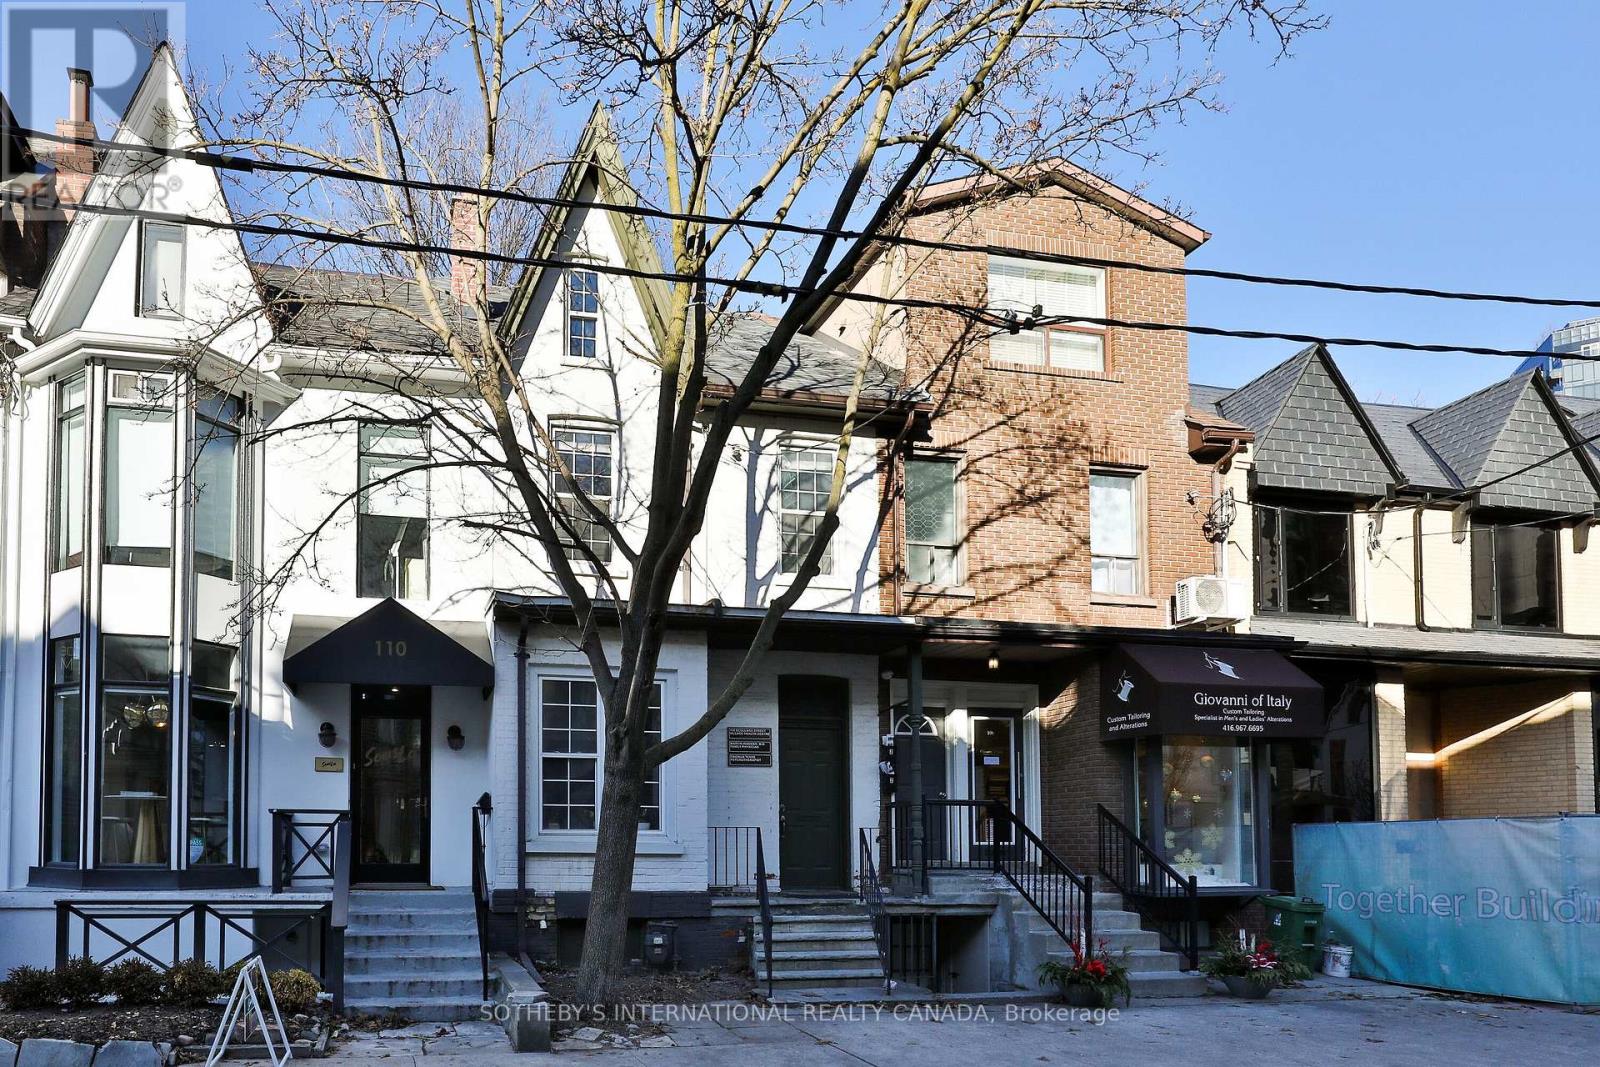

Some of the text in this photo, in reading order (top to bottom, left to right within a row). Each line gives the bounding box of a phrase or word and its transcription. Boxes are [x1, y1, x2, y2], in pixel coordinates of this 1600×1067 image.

[375, 640, 407, 656] 110
[1194, 692, 1292, 710] Giovanni of Italy
[1106, 712, 1151, 724] Custom Tailoring
[1243, 708, 1265, 716] Tailoring
[1120, 721, 1148, 730] Alterations
[1321, 883, 1467, 919] Together
